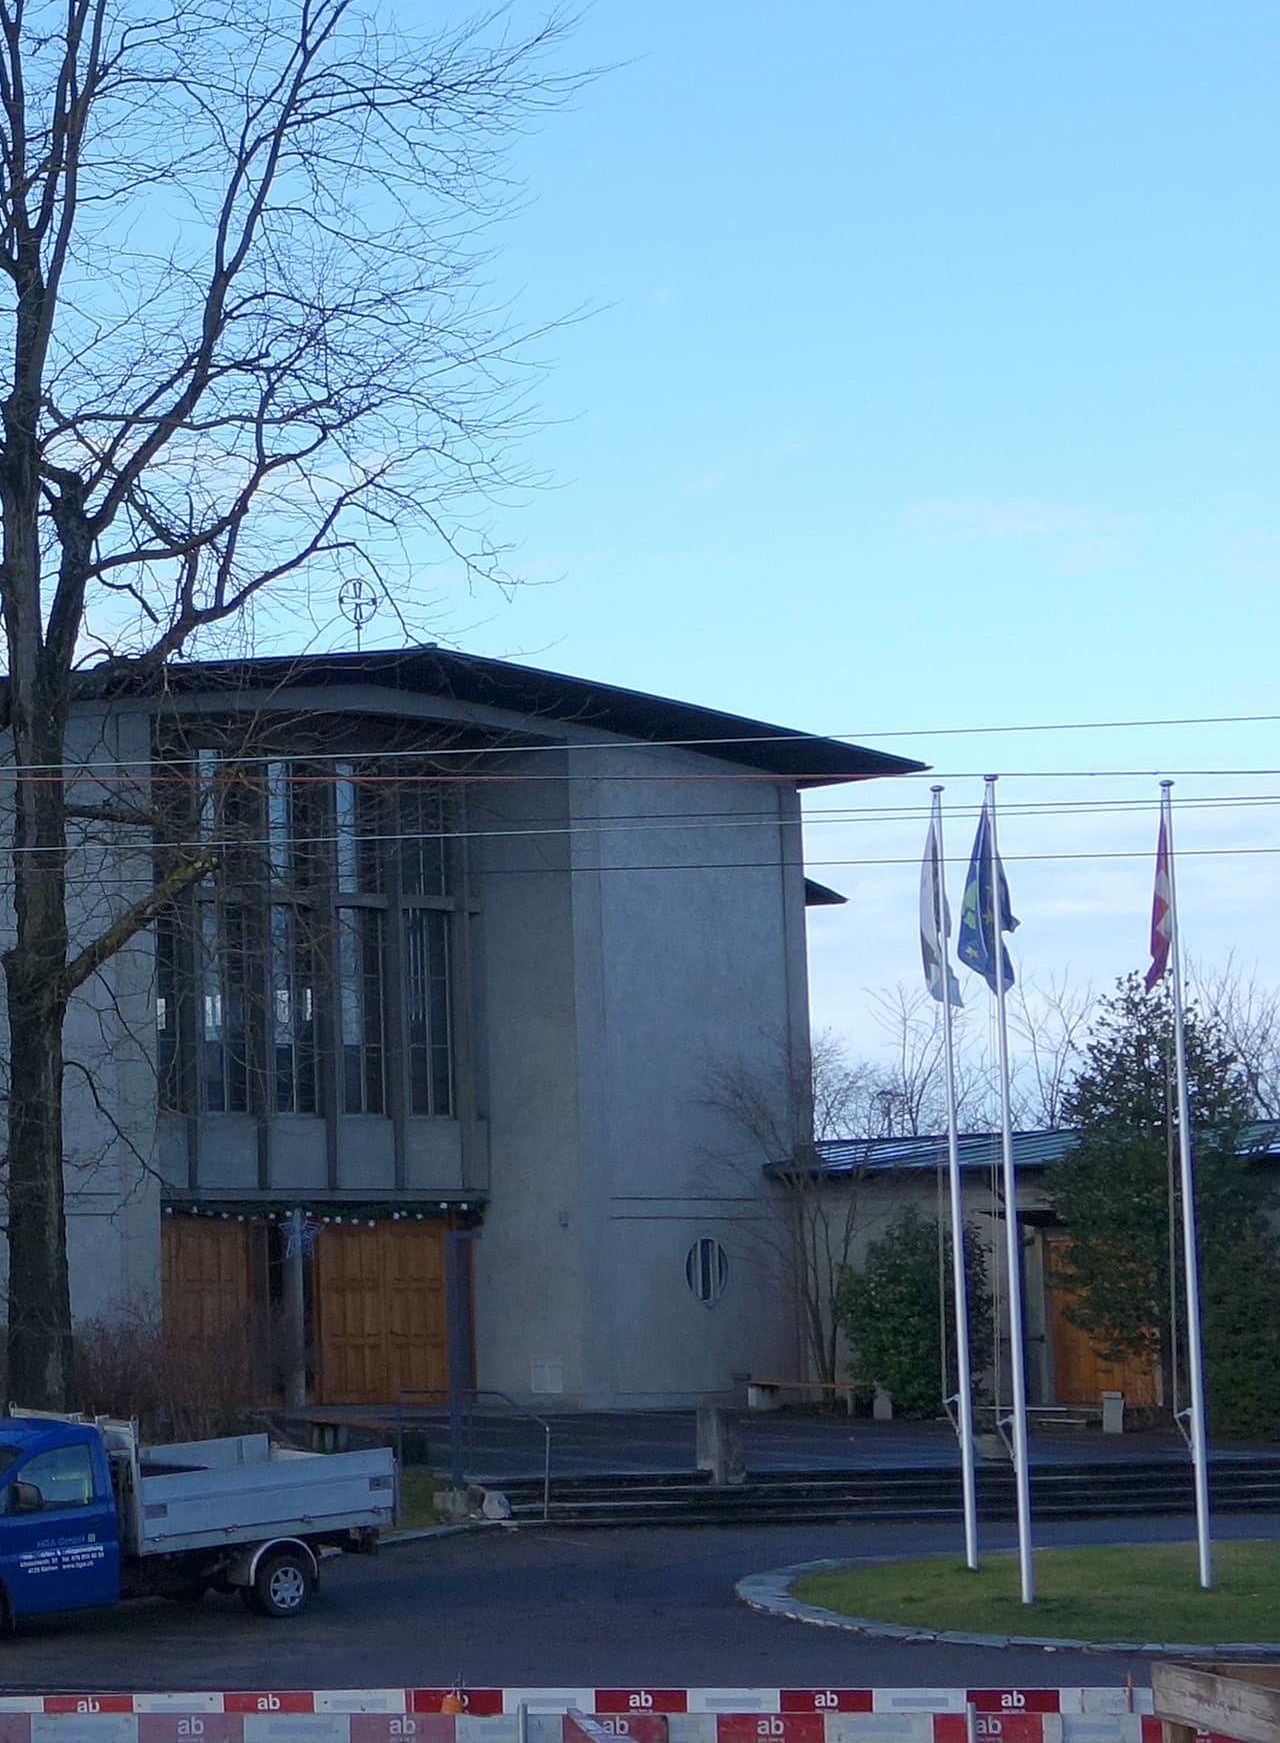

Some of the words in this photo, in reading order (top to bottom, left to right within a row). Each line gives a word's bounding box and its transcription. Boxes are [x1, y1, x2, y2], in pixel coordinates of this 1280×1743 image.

[77, 1698, 99, 1712] ab
[257, 1694, 280, 1710] ab
[629, 1691, 652, 1707] ab
[815, 1691, 838, 1707] ab
[1001, 1691, 1025, 1707] ab
[178, 1716, 204, 1734] ab
[390, 1715, 416, 1734] ab
[603, 1716, 628, 1735] ab
[757, 1717, 784, 1734] ab
[977, 1715, 1002, 1734] ab
